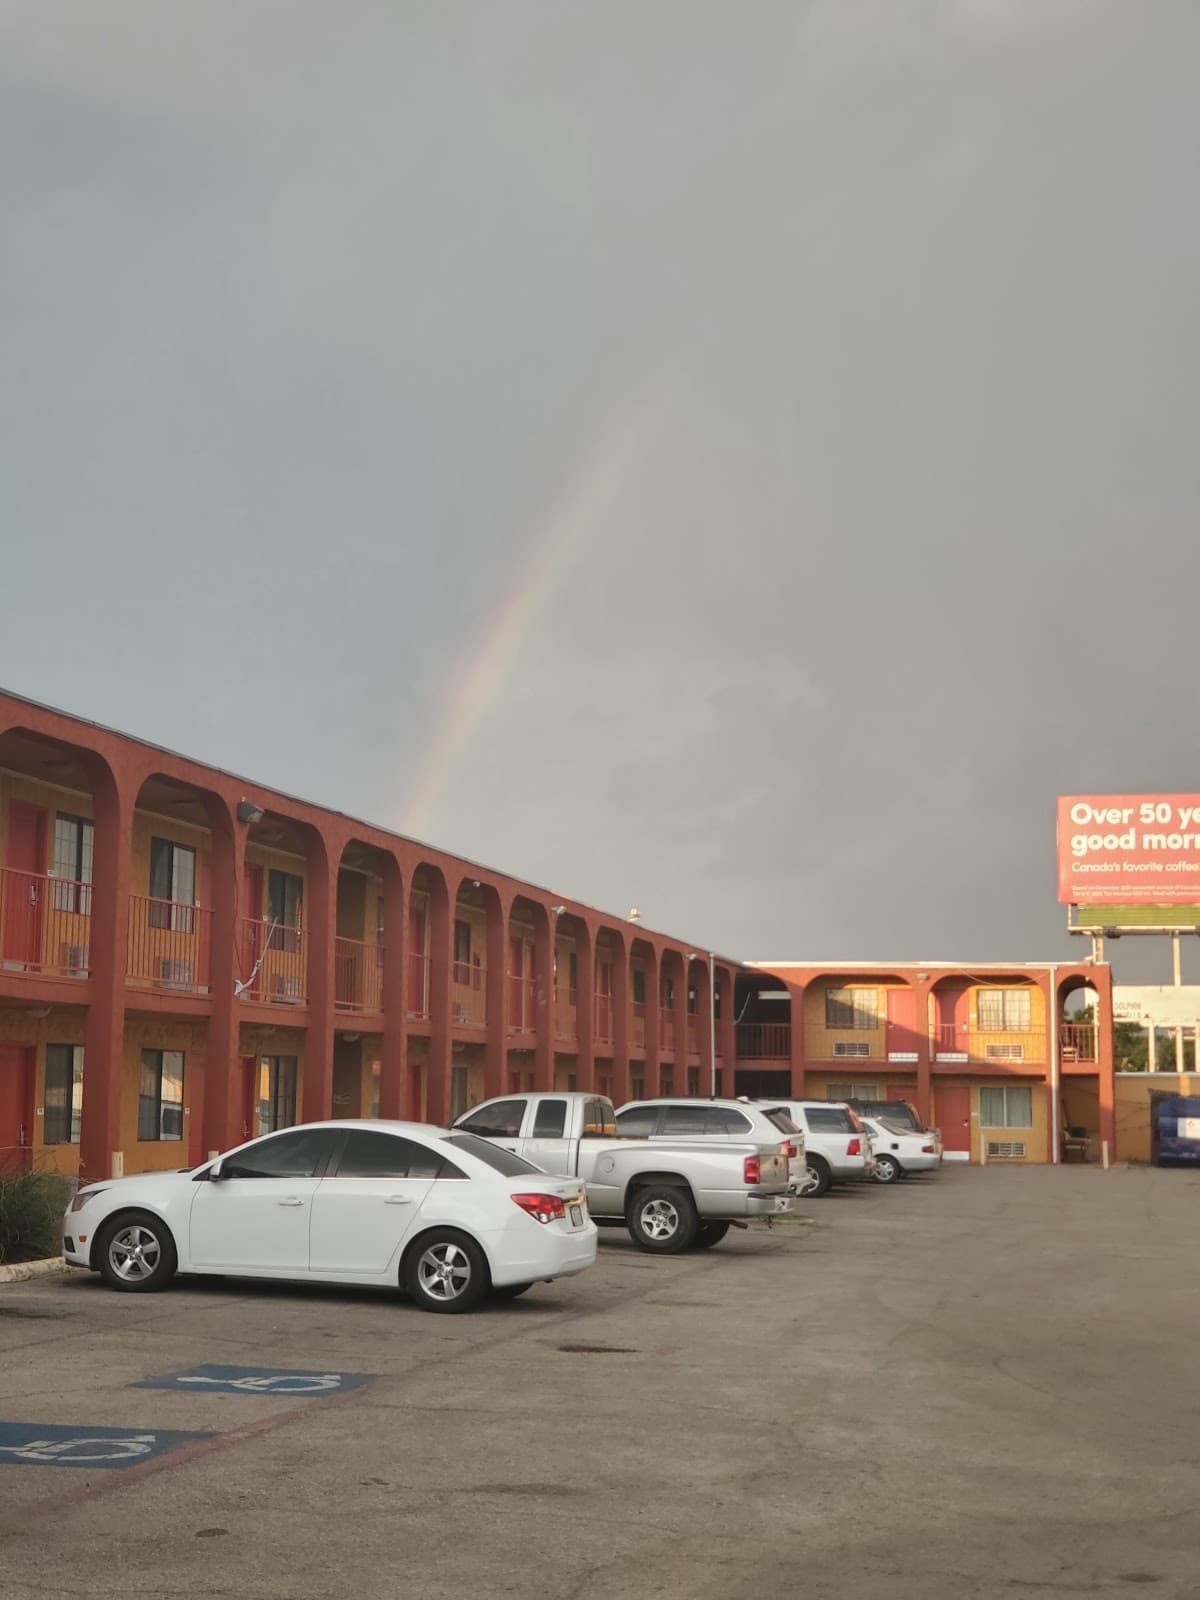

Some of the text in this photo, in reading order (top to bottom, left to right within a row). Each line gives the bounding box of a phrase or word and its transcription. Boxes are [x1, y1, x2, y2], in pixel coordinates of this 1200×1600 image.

[1070, 803, 1134, 825] Over
[1139, 803, 1172, 825] 50
[1071, 827, 1136, 857] good
[1071, 862, 1120, 873] Canada's
[1123, 861, 1163, 873] favorite
